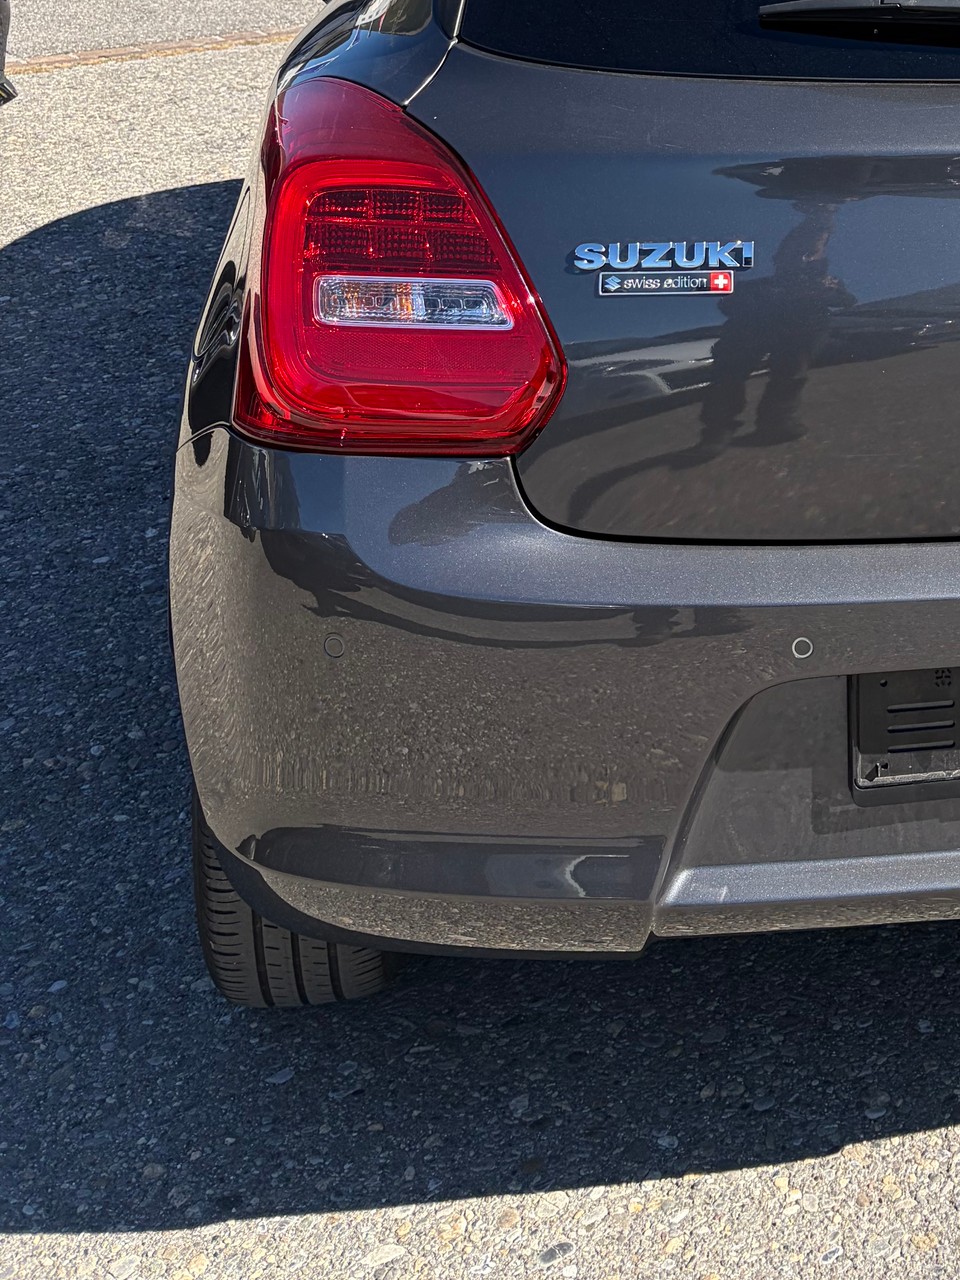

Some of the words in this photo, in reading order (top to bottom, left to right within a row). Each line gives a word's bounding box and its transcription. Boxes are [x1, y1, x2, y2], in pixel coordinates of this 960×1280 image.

[573, 241, 755, 270] SUZUKI
[623, 277, 660, 289] swiss
[663, 276, 708, 289] edition
